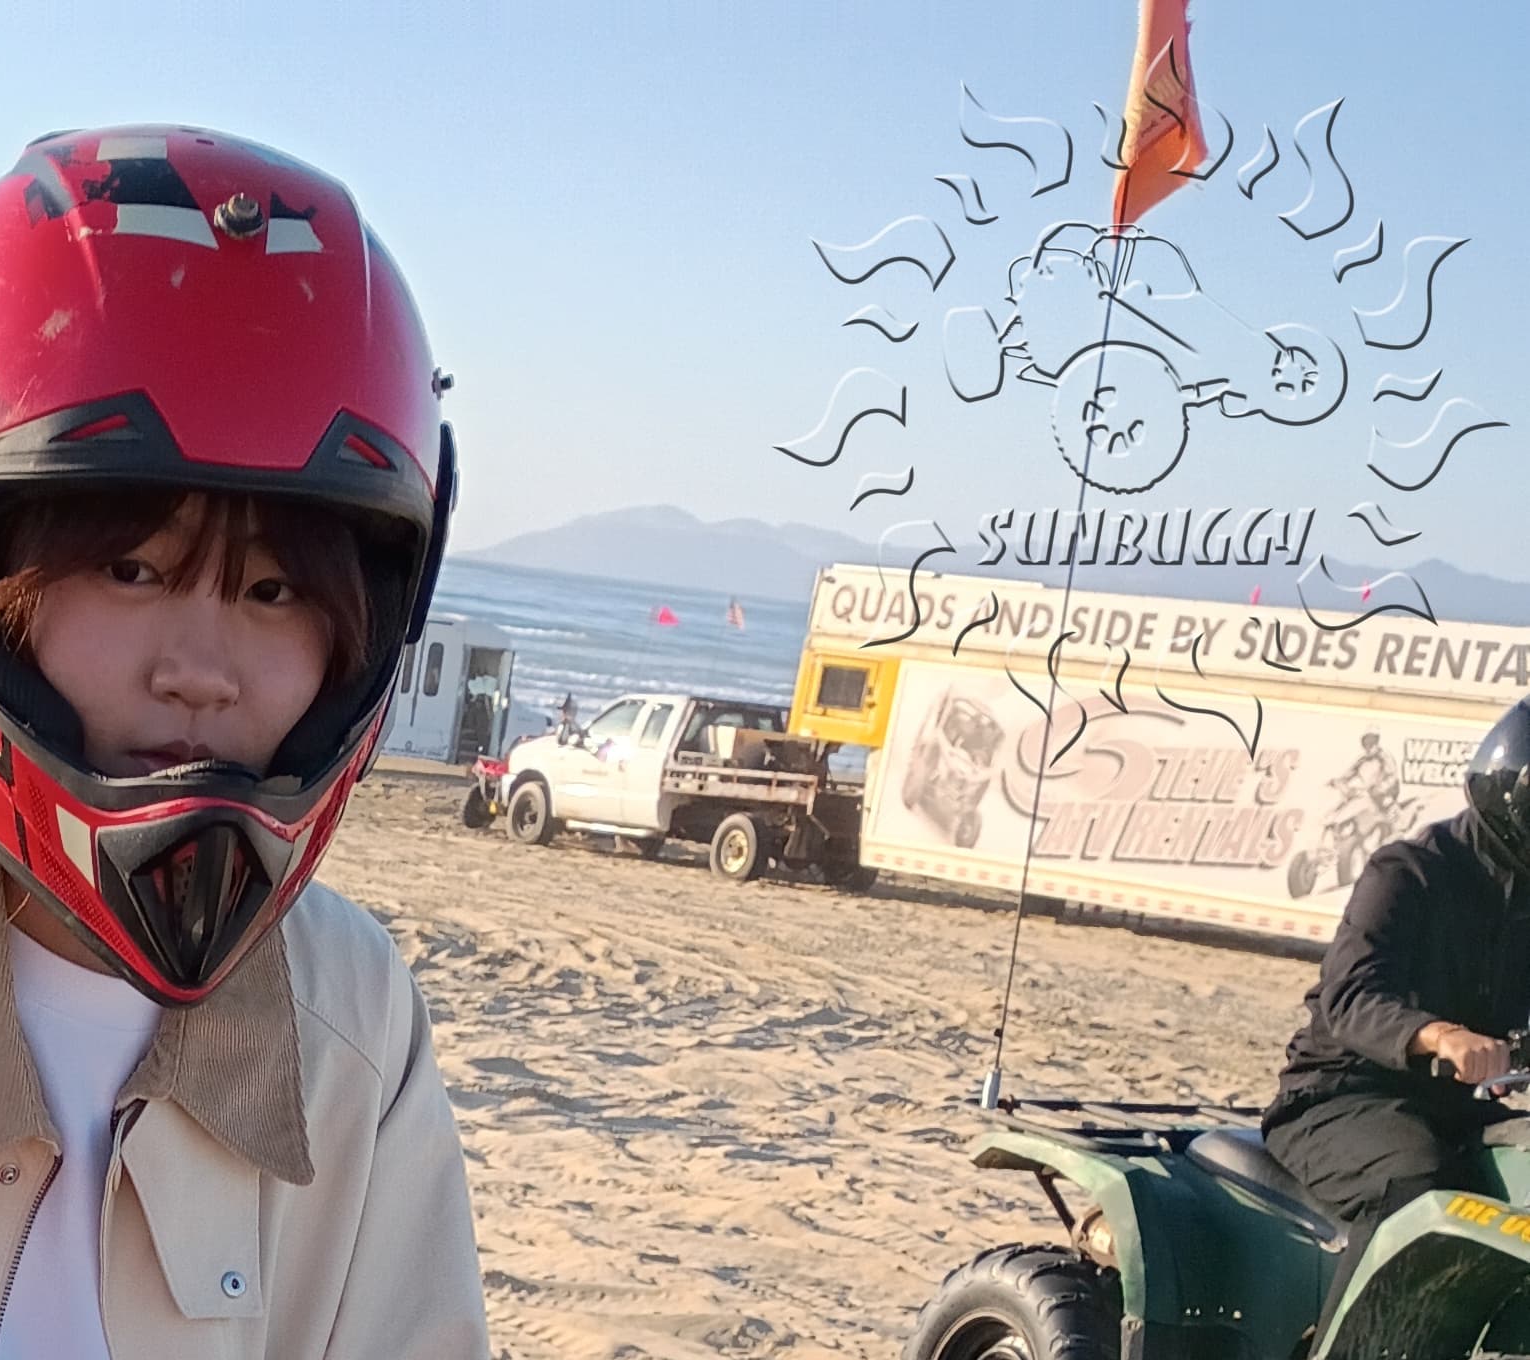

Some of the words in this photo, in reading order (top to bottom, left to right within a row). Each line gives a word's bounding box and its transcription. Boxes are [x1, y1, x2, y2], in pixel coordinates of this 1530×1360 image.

[831, 584, 958, 630] QUADS
[971, 598, 1054, 639] AND
[1067, 606, 1159, 650] SIDE
[1170, 615, 1227, 656] BY
[1234, 619, 1360, 670] SIDES
[1030, 800, 1132, 861] ATV
[1110, 800, 1305, 869] RENTALS
